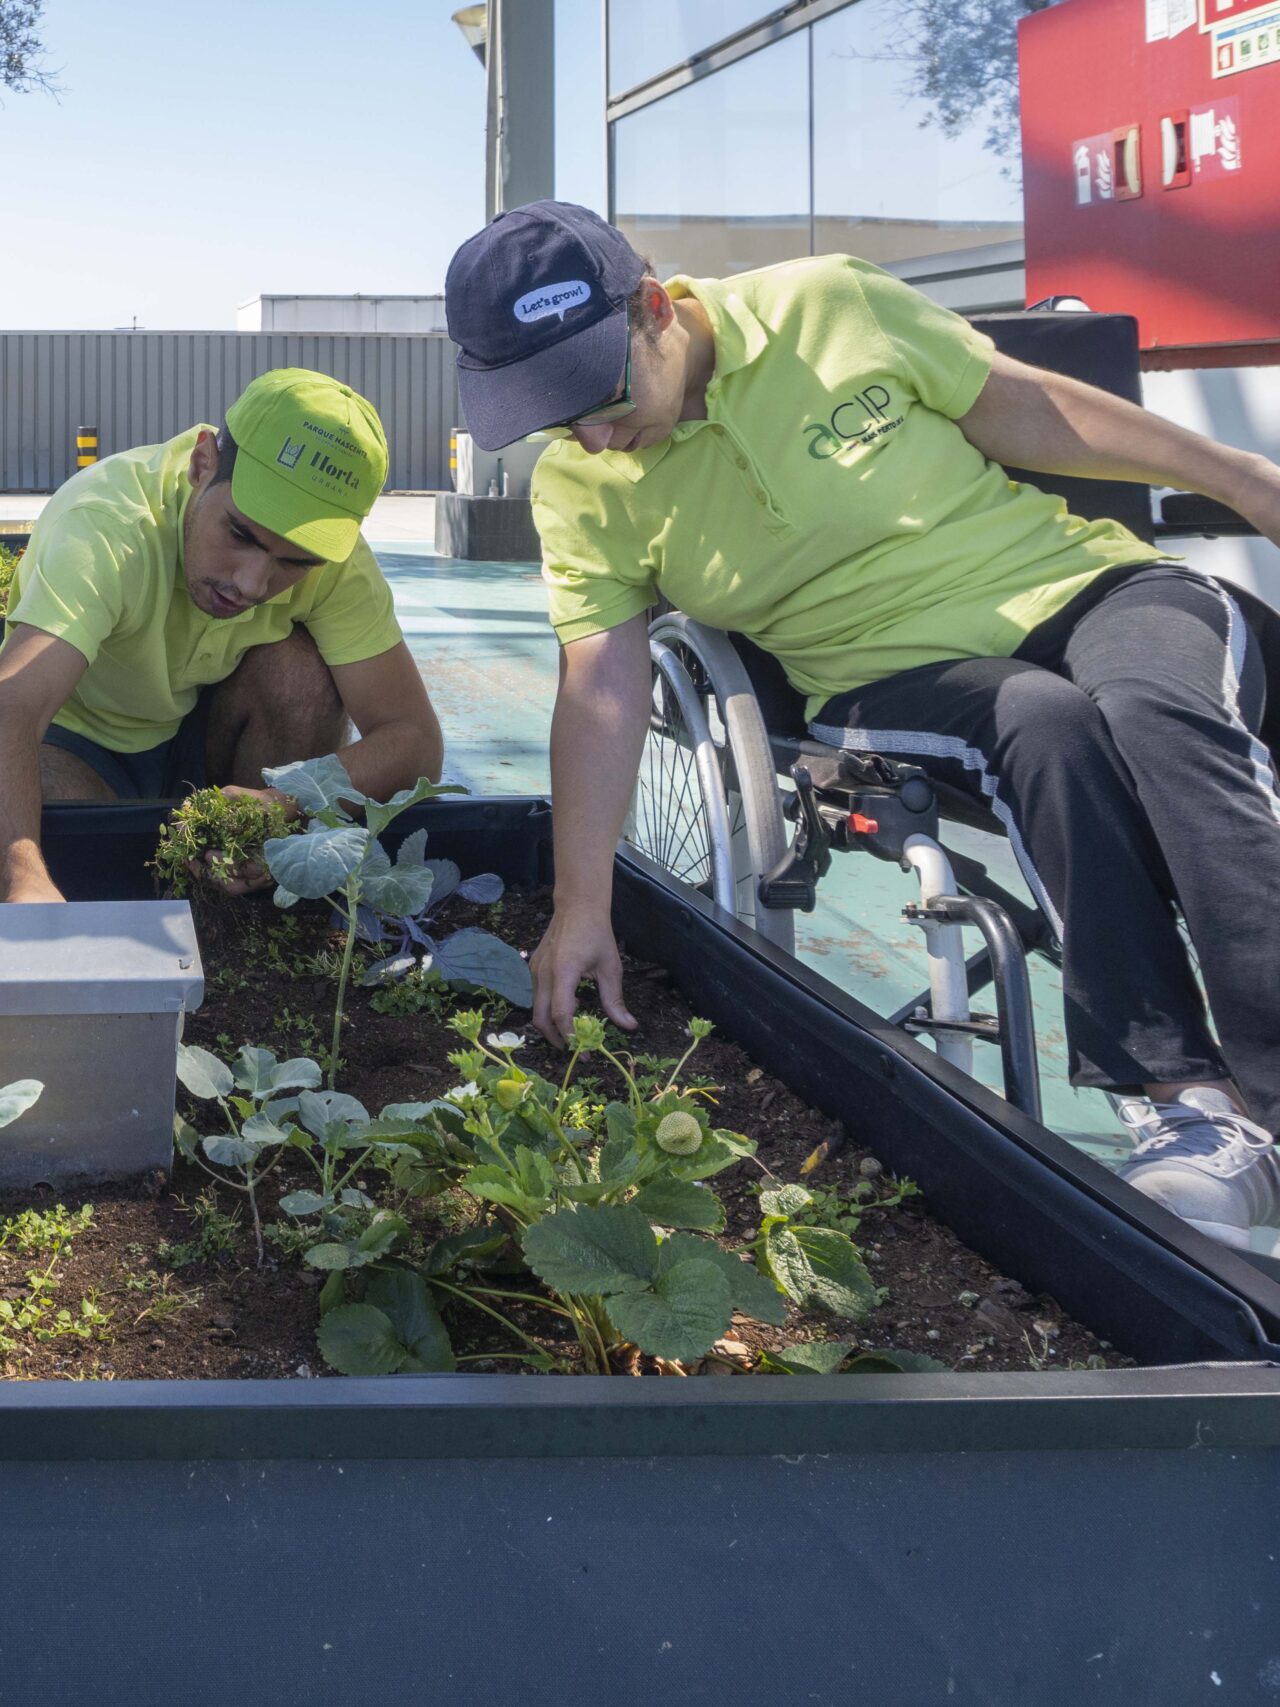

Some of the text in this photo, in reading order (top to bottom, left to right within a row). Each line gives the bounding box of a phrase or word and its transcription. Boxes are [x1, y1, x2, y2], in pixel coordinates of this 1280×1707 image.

[522, 286, 583, 314] Let's grow!
[303, 421, 335, 441] PARQUE
[335, 437, 368, 459] NASCENTE
[310, 451, 360, 490] Horta
